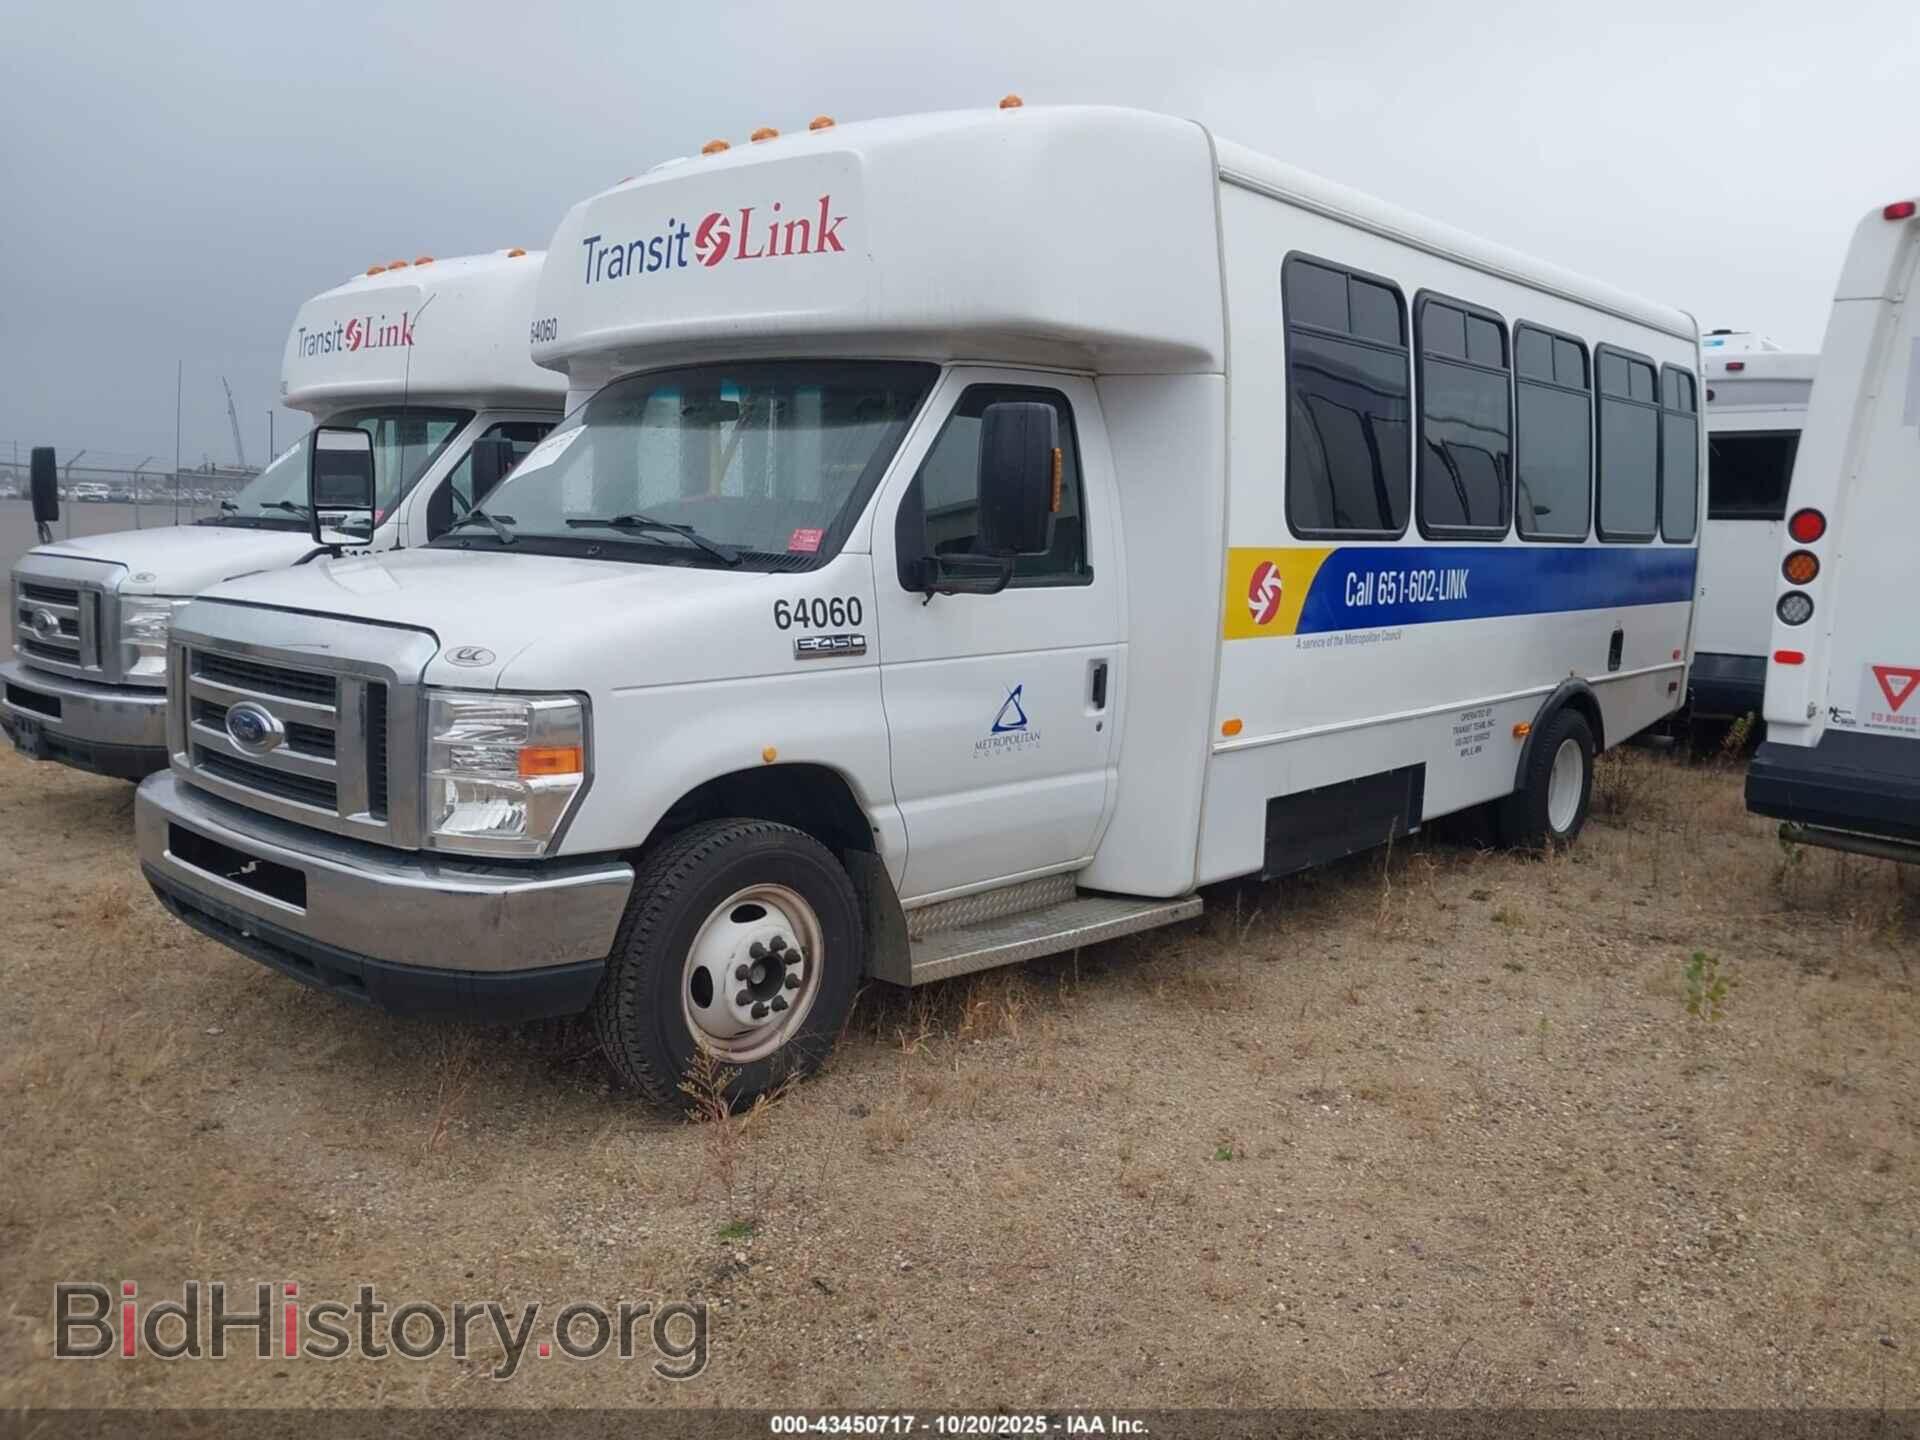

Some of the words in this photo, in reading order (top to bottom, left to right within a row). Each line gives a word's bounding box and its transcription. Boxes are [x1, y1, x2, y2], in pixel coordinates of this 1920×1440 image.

[583, 217, 690, 284] Transit
[733, 194, 848, 260] Link
[297, 320, 343, 358] Transit
[364, 311, 416, 349] Link
[530, 318, 557, 344] 64060
[1345, 572, 1374, 607] Call
[1377, 568, 1470, 606] 651-602-LINK
[773, 596, 863, 631] 64060
[1302, 637, 1325, 649] service
[1326, 635, 1334, 647] of
[1334, 635, 1343, 646] the
[1345, 631, 1381, 647] Metropolitan
[1381, 629, 1402, 642] Council
[975, 730, 1040, 750] METROPOLITAN
